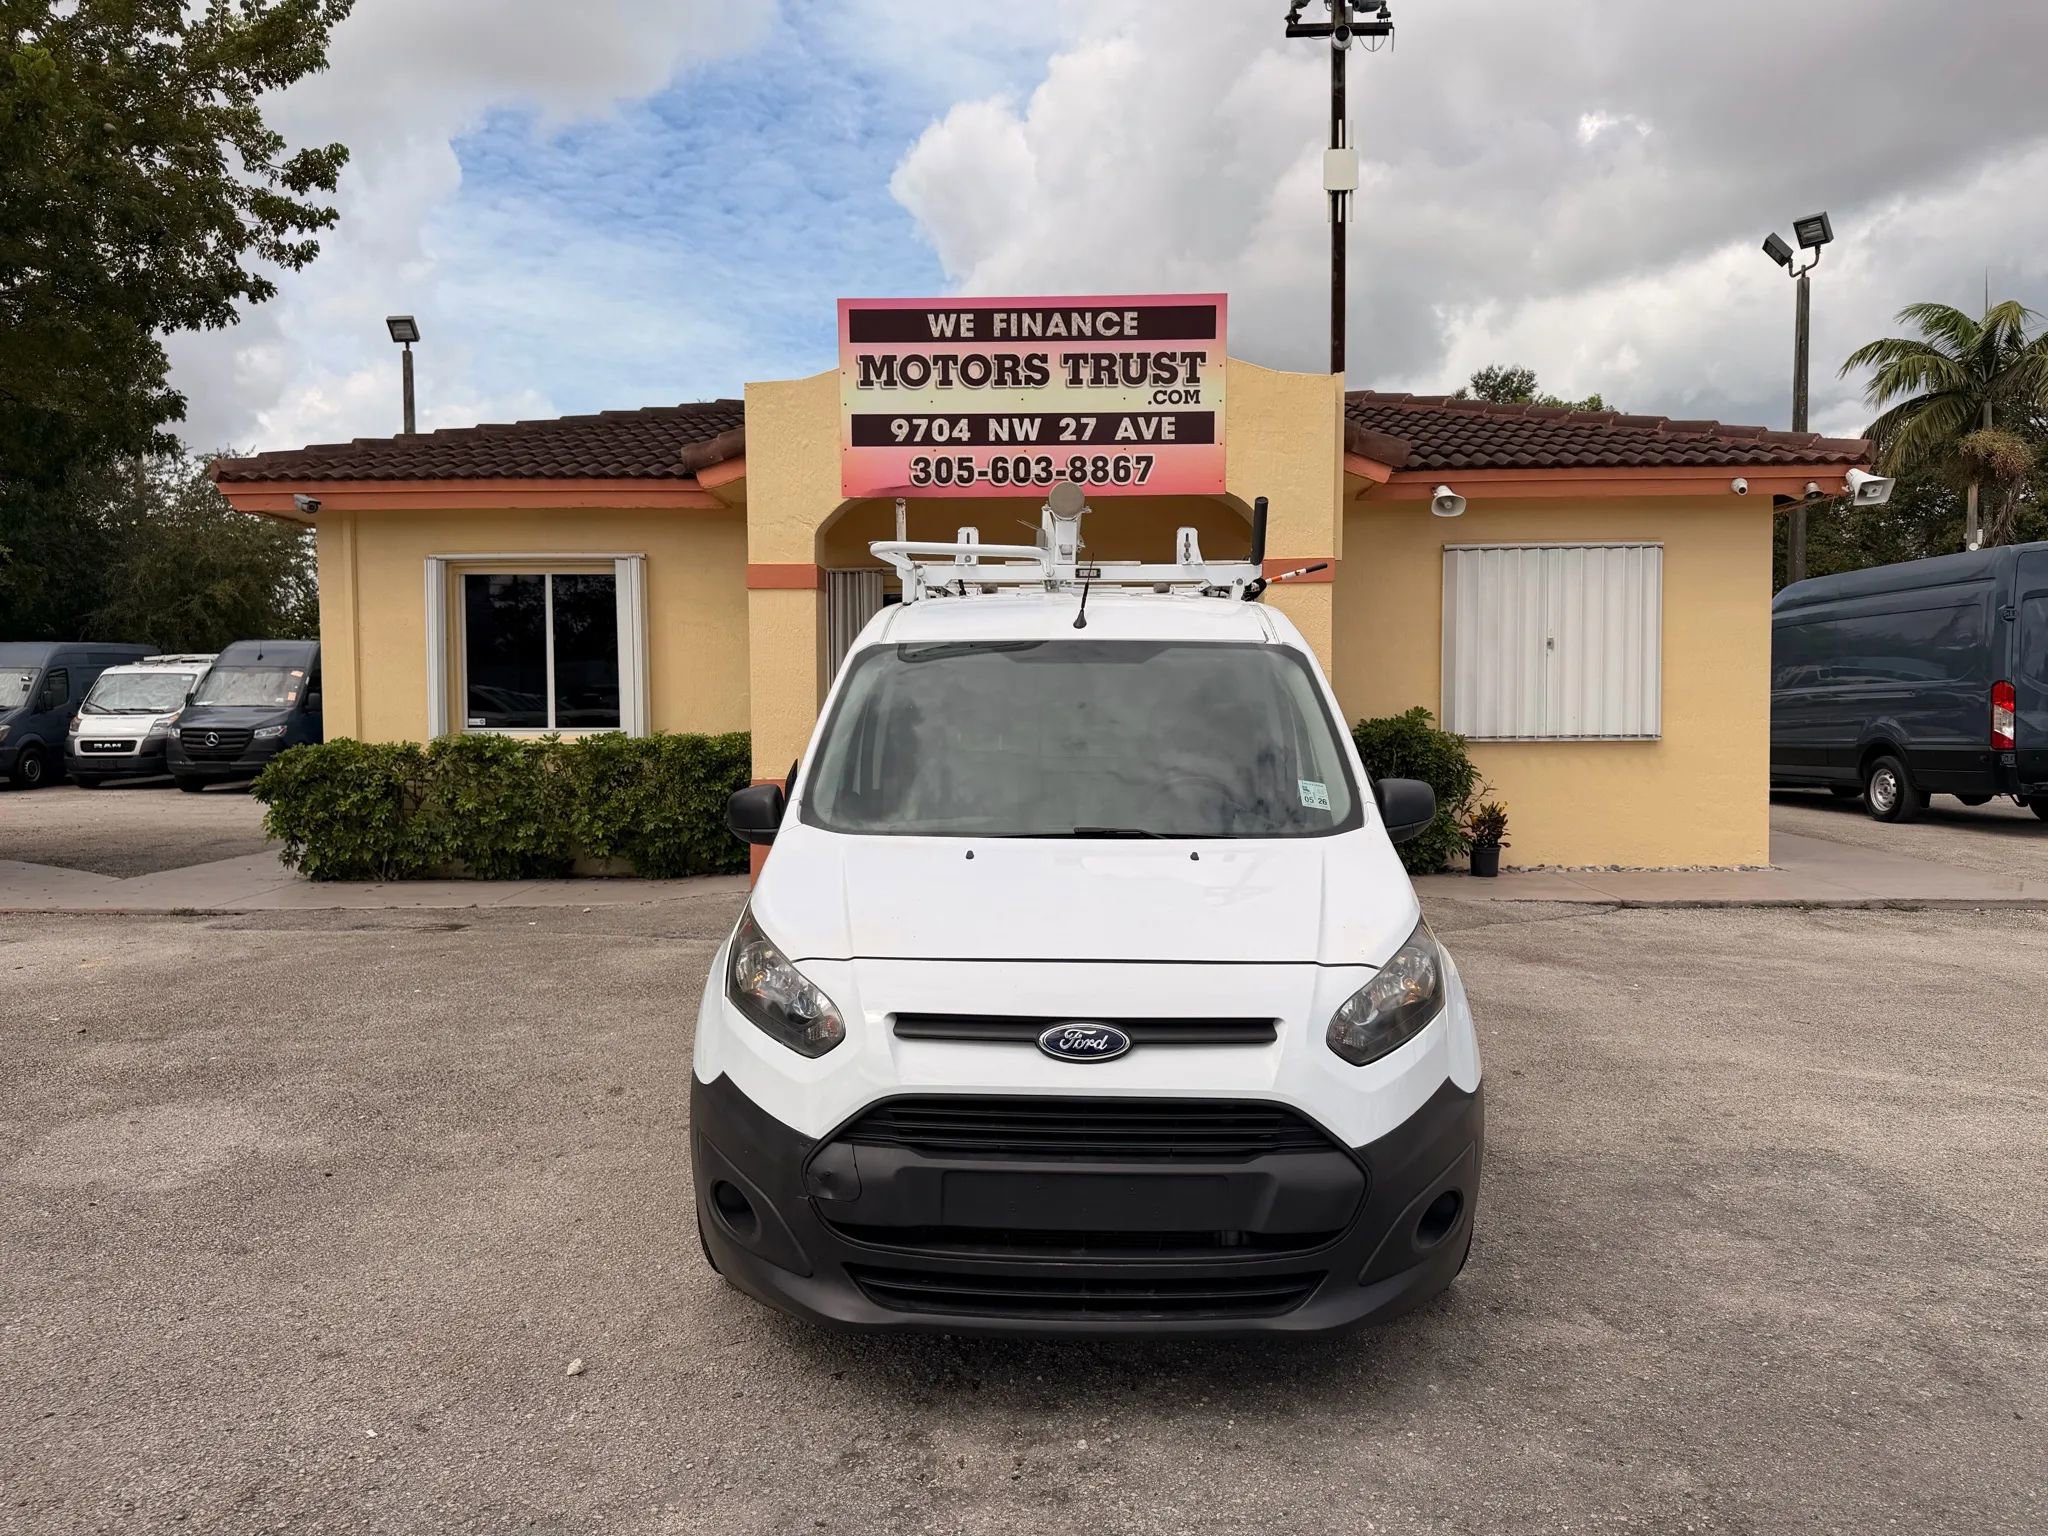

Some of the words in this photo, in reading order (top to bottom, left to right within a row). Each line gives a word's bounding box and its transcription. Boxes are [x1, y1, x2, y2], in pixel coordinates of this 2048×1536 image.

[927, 313, 974, 337] WE
[993, 312, 1138, 336] FINANCE
[857, 354, 1050, 388] MOTORS
[1061, 352, 1206, 386] TRUST
[1148, 390, 1200, 405] .COM
[890, 419, 970, 441] 9704
[988, 418, 1041, 441] NW
[1059, 418, 1096, 440] 27
[1115, 417, 1175, 439] AVE
[910, 456, 1154, 485] 305-603-8867
[1060, 1029, 1108, 1050] Ford
